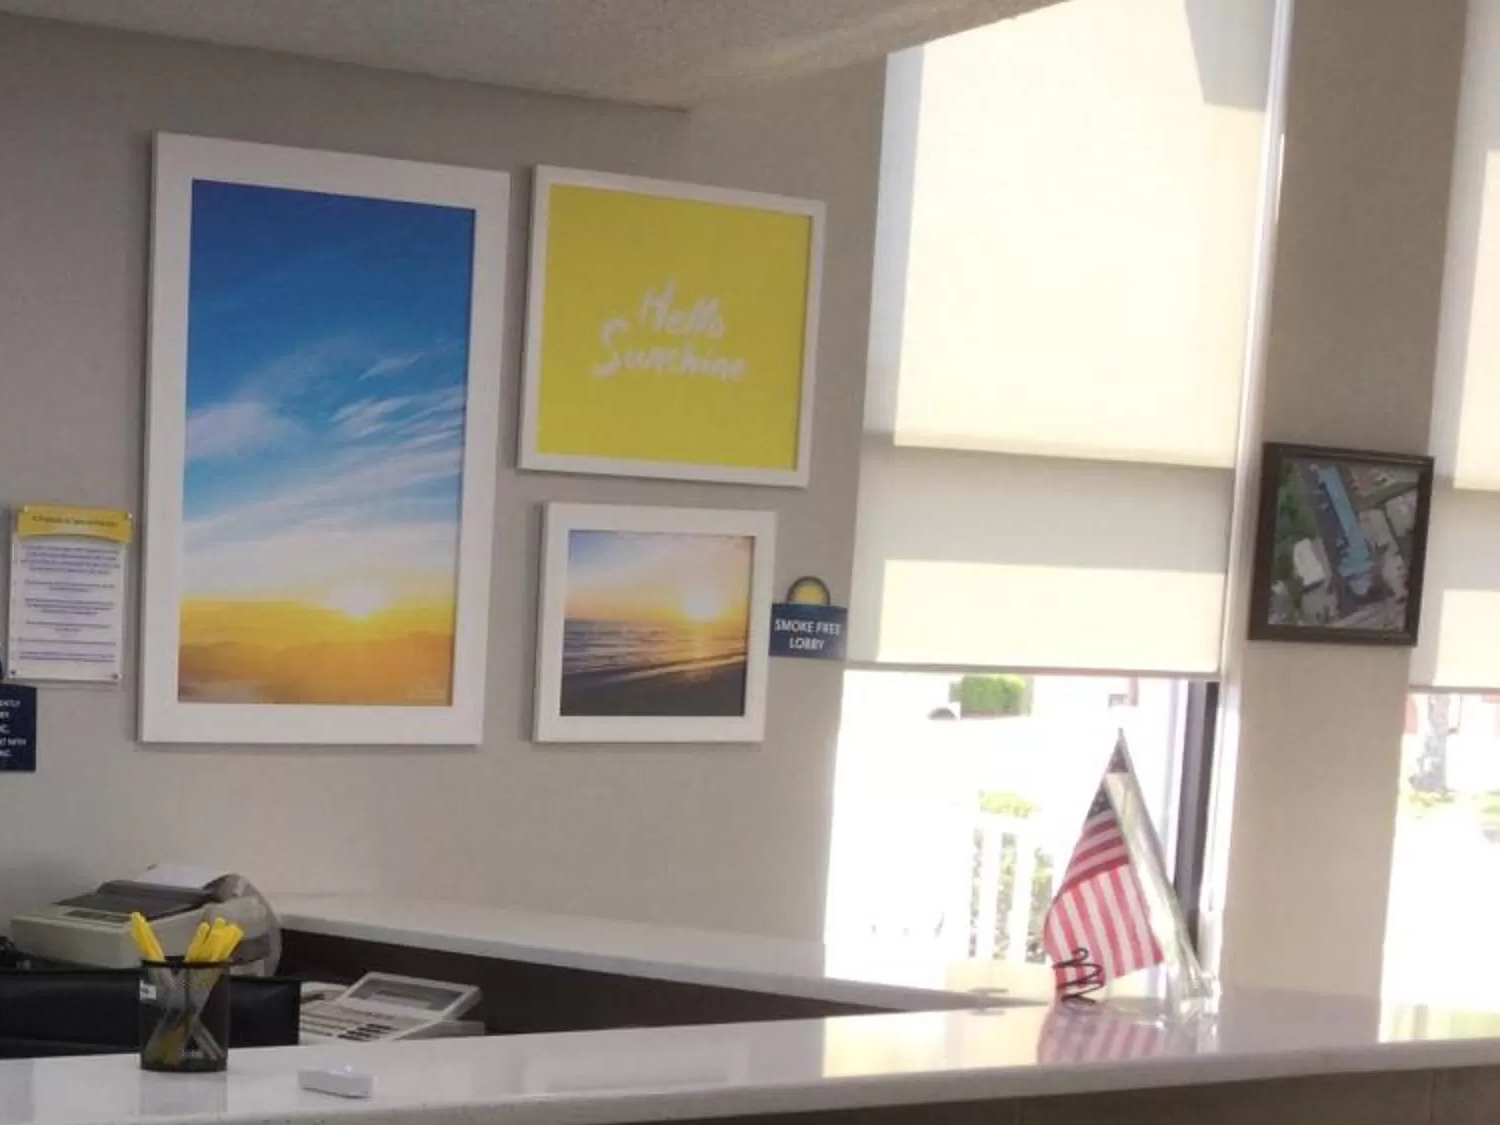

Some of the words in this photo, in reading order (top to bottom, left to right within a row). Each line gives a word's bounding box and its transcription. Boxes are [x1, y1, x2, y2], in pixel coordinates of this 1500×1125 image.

[639, 276, 725, 338] Hello
[591, 318, 748, 382] Sunshine
[774, 618, 815, 633] SMOKE
[789, 636, 825, 651] LOBBY
